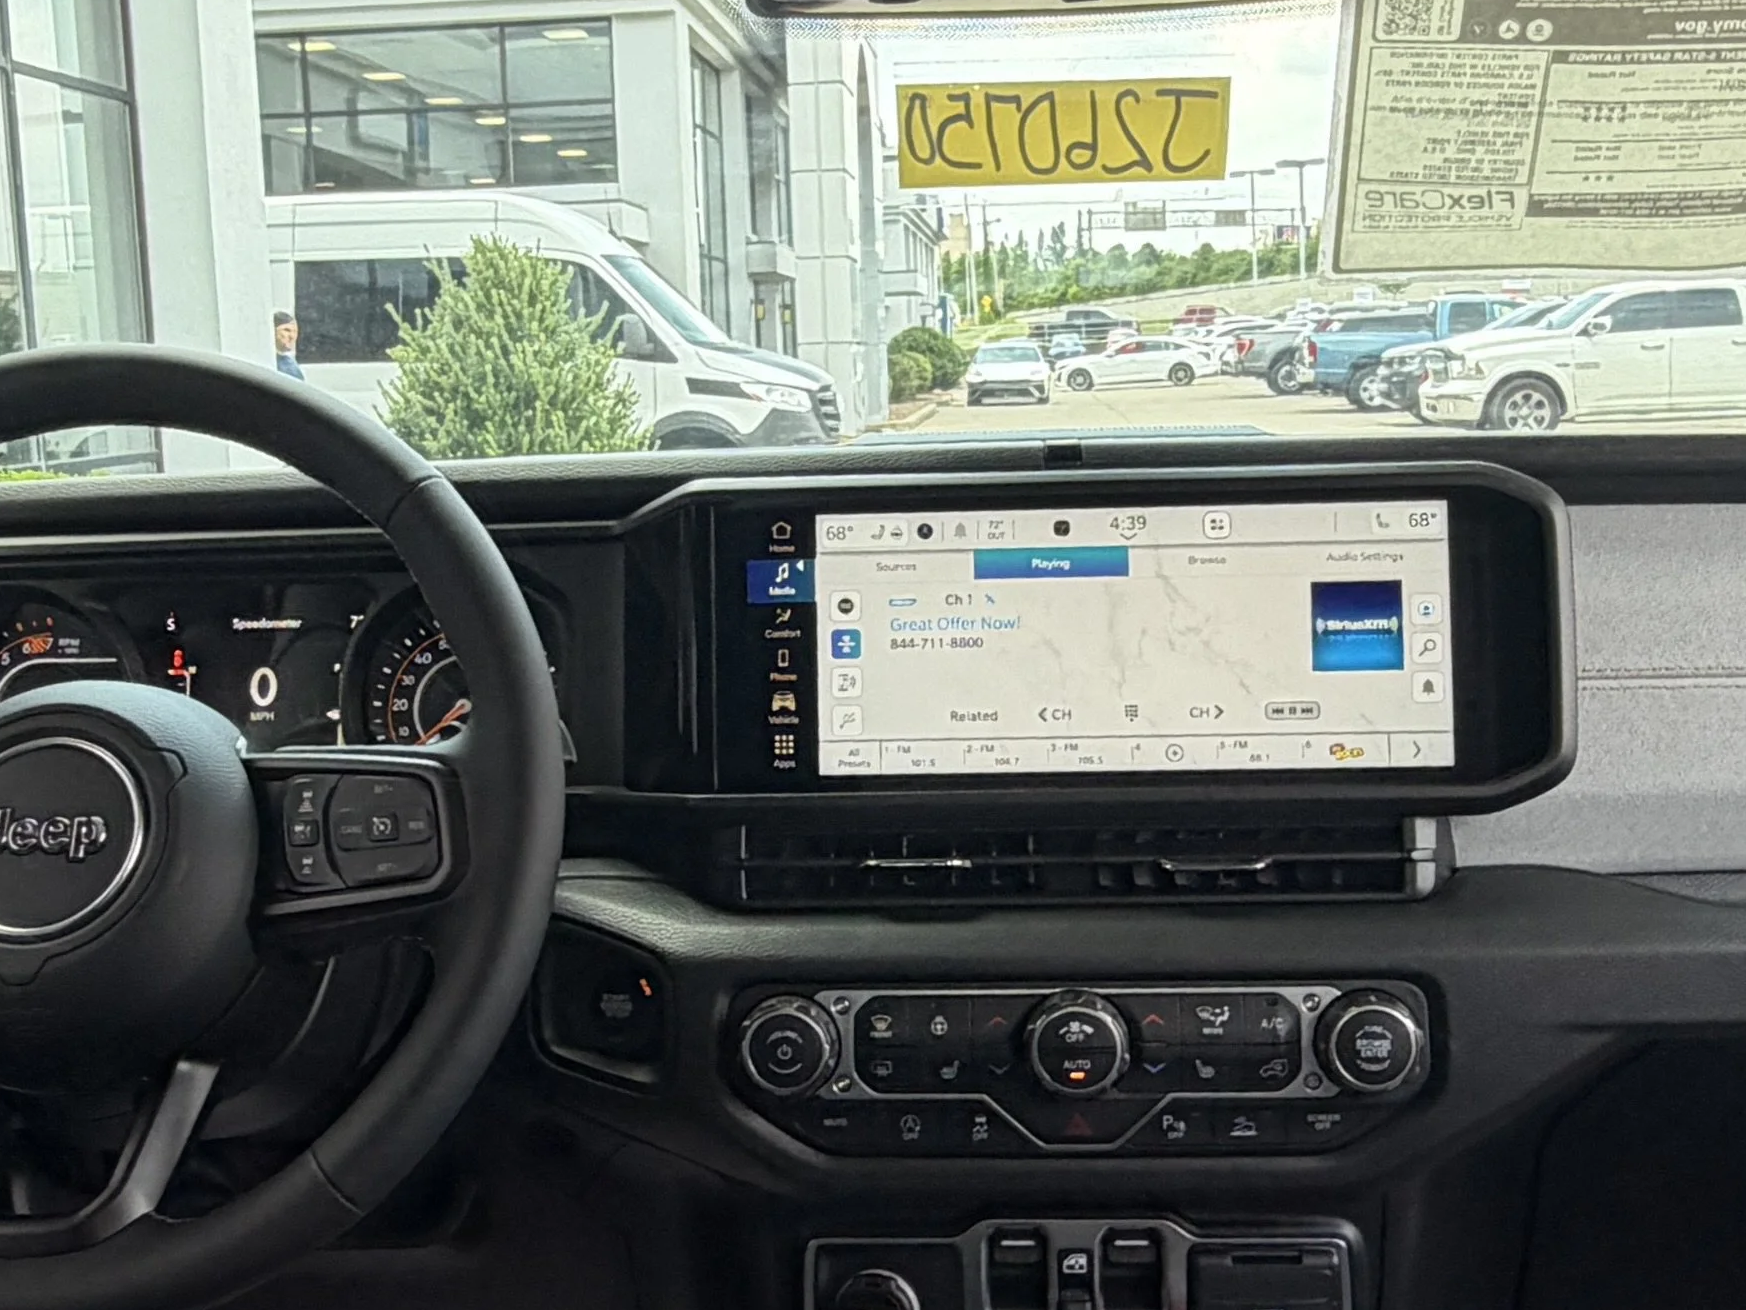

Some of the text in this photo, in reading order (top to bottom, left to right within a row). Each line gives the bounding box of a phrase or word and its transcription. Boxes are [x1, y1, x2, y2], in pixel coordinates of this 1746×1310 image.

[1108, 515, 1147, 532] 4:39
[1408, 512, 1438, 528] 68°
[825, 524, 854, 541] 68°
[1030, 557, 1070, 571] Playing
[1188, 555, 1227, 566] Browse
[1325, 552, 1404, 563] Audio Settings
[874, 561, 917, 573] Sources
[944, 594, 963, 606] Ch
[232, 616, 302, 631] Speedometer
[889, 615, 1021, 631] Great Offer Now!
[764, 629, 801, 639] Comfort
[889, 636, 983, 650] 844-711-8800
[413, 652, 432, 665] 40
[249, 666, 278, 708] 0
[400, 675, 415, 687] 30
[392, 698, 408, 712] 20
[249, 711, 275, 721] MPH
[950, 709, 997, 723] Related
[1050, 709, 1071, 721] CH
[1189, 706, 1209, 719] CH
[398, 725, 410, 738] 10
[773, 759, 796, 769] Apps
[1260, 1017, 1284, 1030] A/C
[1065, 1032, 1085, 1043] OFF
[1062, 1058, 1091, 1070] AUTO
[1314, 1122, 1332, 1131] OFF
